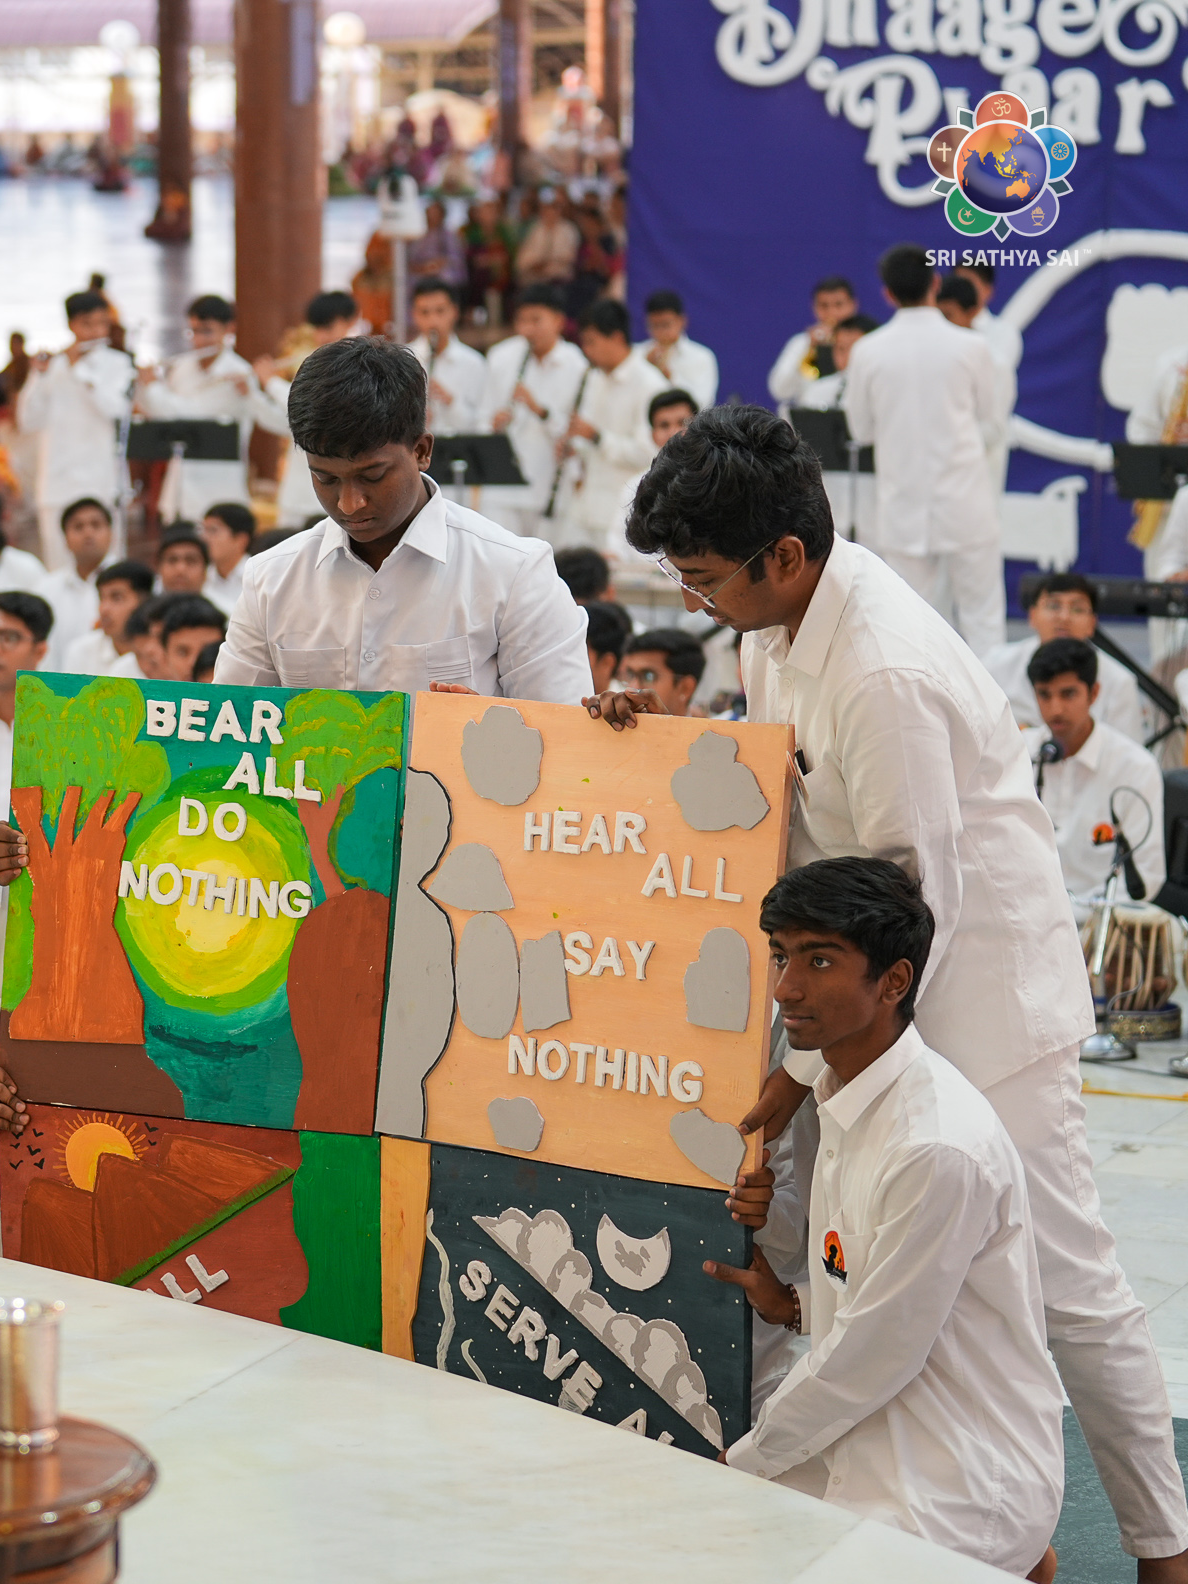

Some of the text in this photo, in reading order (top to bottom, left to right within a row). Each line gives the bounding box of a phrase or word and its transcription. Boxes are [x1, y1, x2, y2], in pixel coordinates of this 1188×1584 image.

[146, 698, 284, 744] BEAR
[222, 751, 321, 802] ALL
[178, 796, 247, 842] DO
[523, 811, 648, 855] HEAR
[118, 860, 313, 919] NOTHING
[640, 853, 743, 902] ALL
[563, 930, 656, 981] SAY
[507, 1034, 705, 1103] NOTHING
[144, 1253, 230, 1304] LL
[459, 1260, 675, 1445] SERVE A
